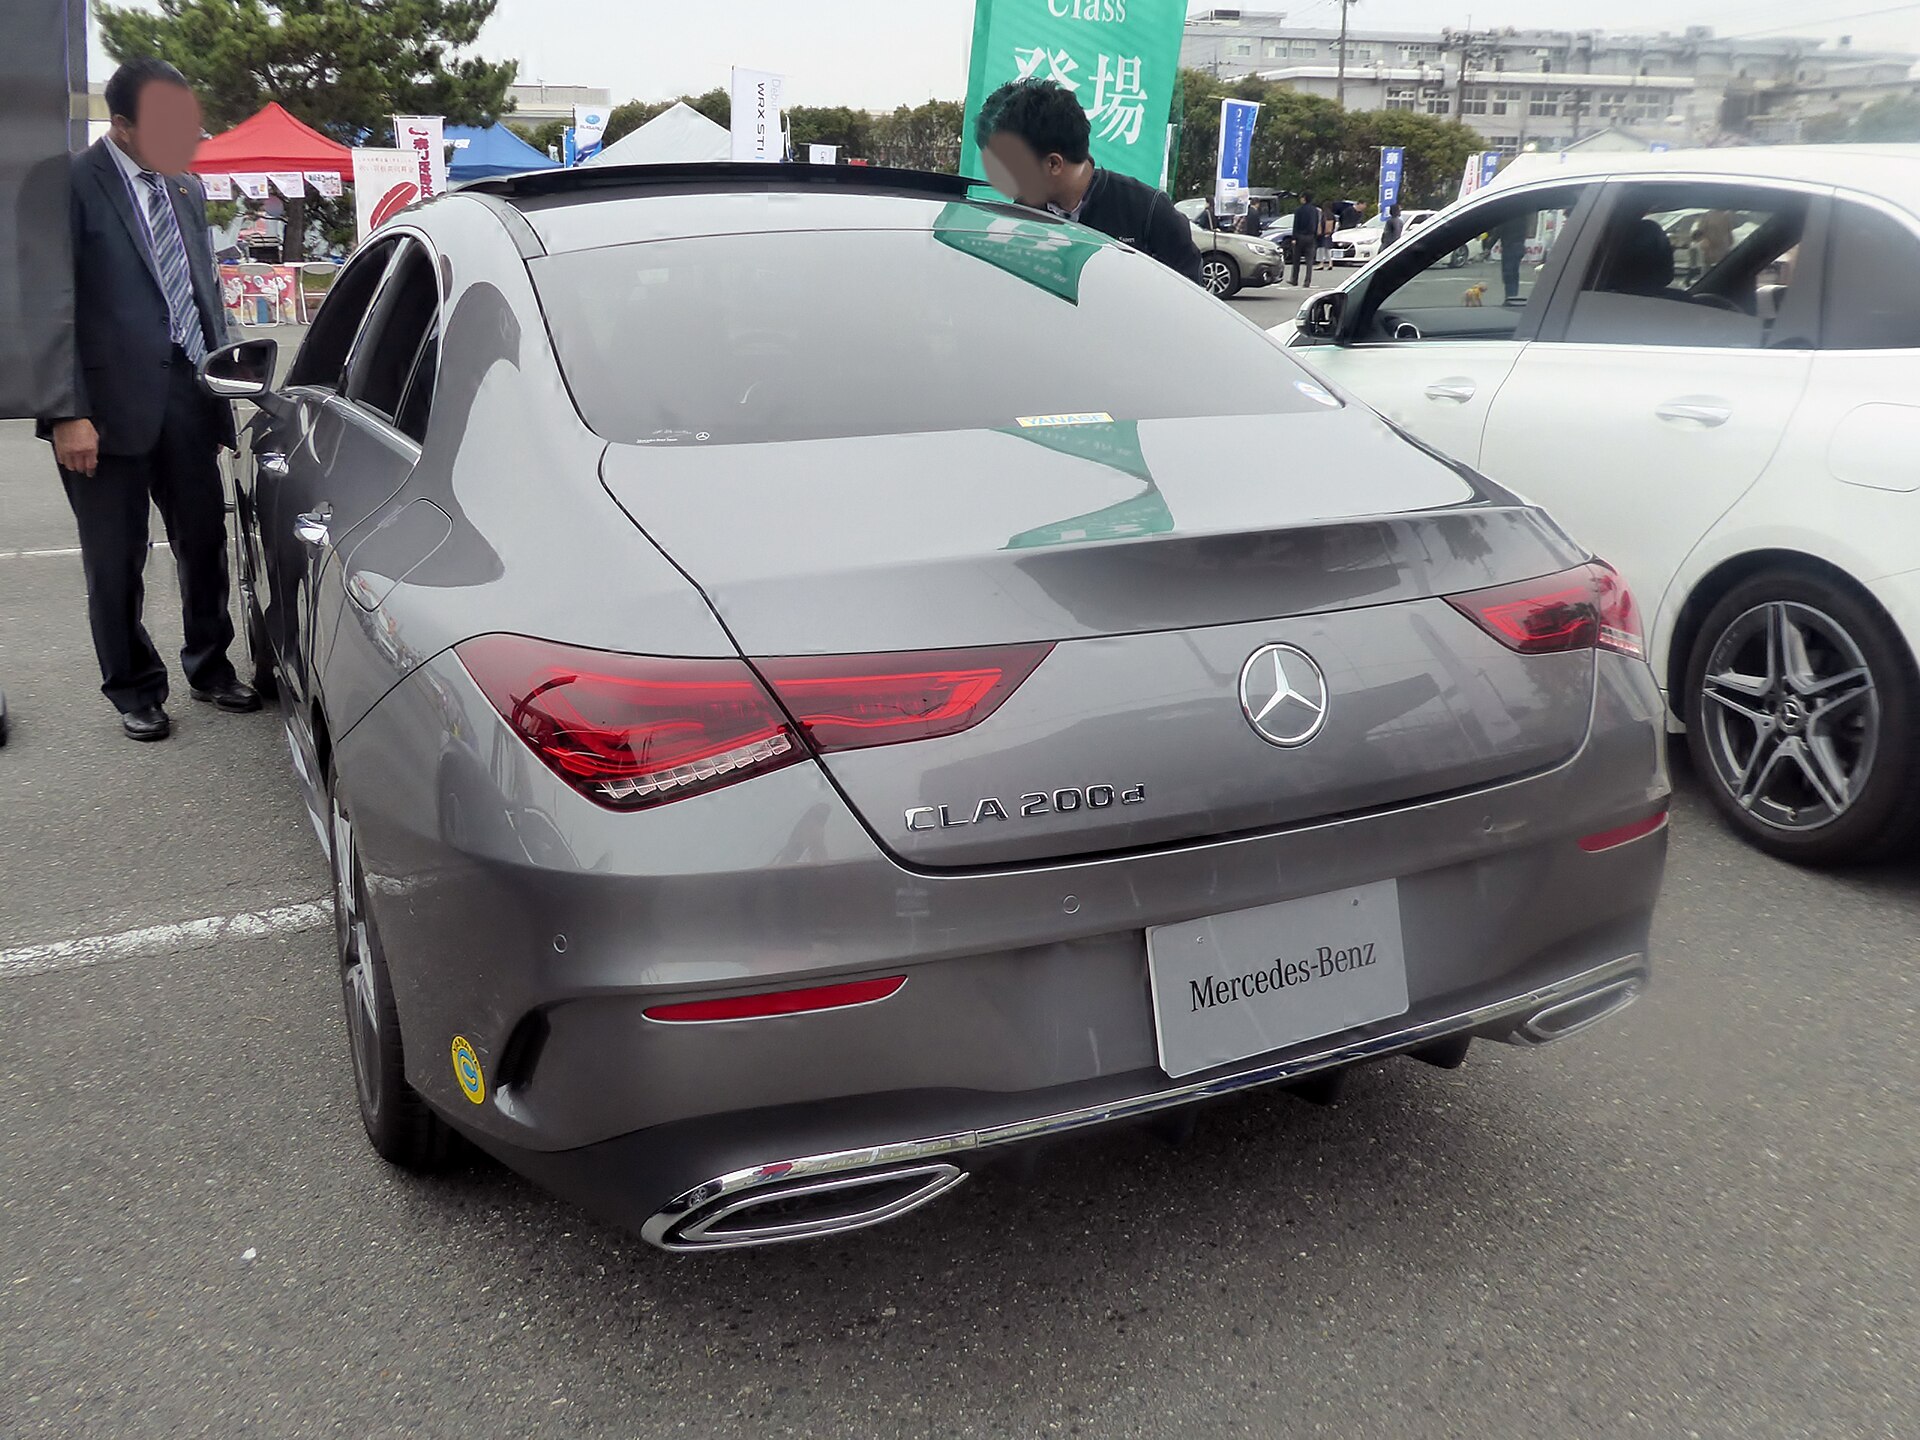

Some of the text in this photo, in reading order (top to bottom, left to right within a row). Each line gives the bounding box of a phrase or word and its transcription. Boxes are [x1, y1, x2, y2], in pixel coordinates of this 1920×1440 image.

[1047, 0, 1126, 23] Class
[757, 83, 765, 151] WRX STI
[904, 797, 1009, 832] CLA
[1189, 942, 1377, 1012] Mercedes-Benz
